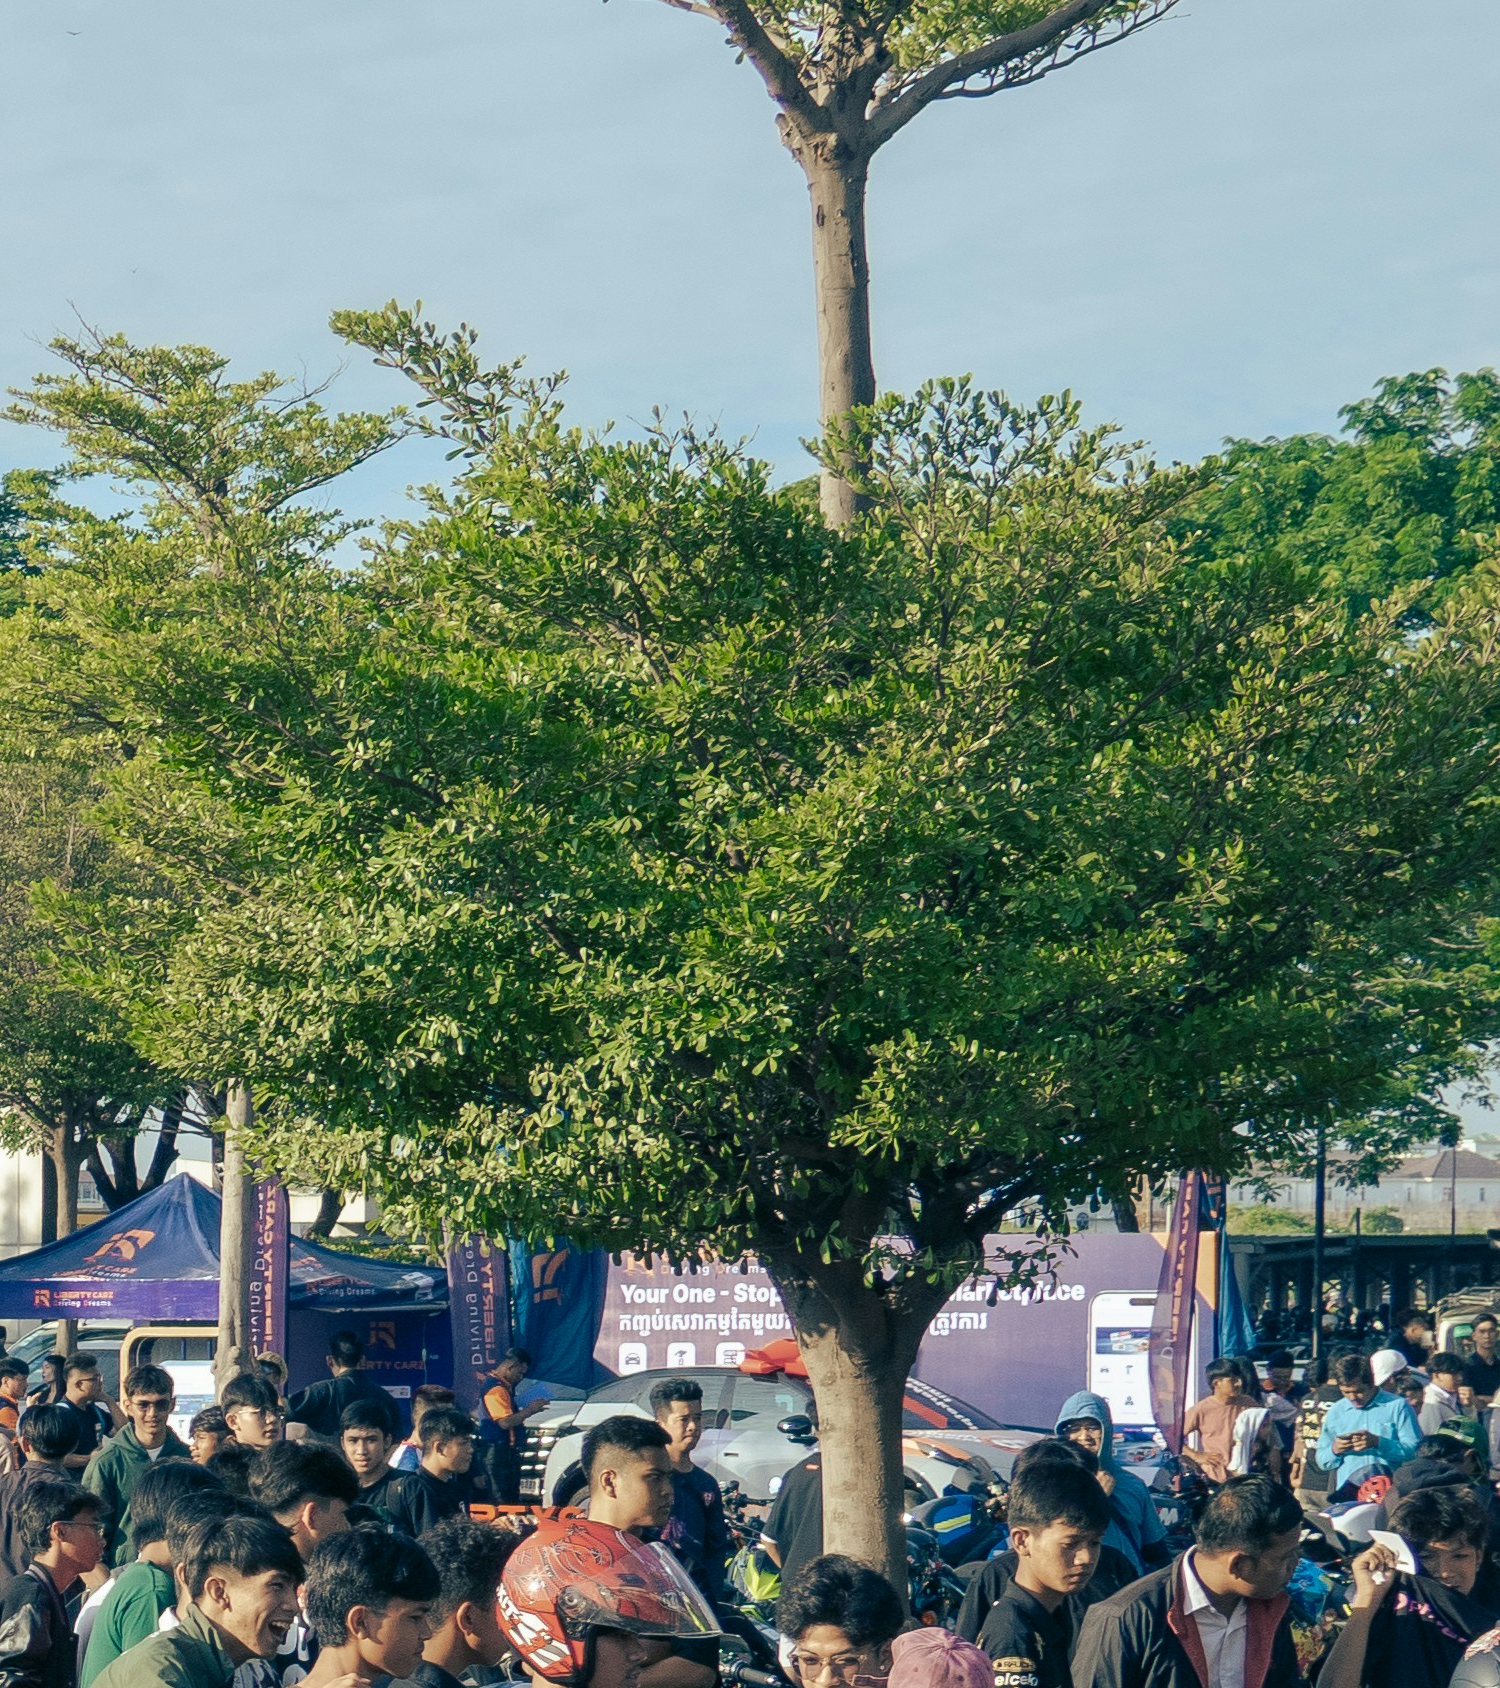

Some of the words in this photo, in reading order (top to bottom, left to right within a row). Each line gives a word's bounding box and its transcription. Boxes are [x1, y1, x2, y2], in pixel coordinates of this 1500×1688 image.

[620, 1284, 670, 1303] Your
[673, 1283, 716, 1303] One
[733, 1283, 782, 1307] Stop
